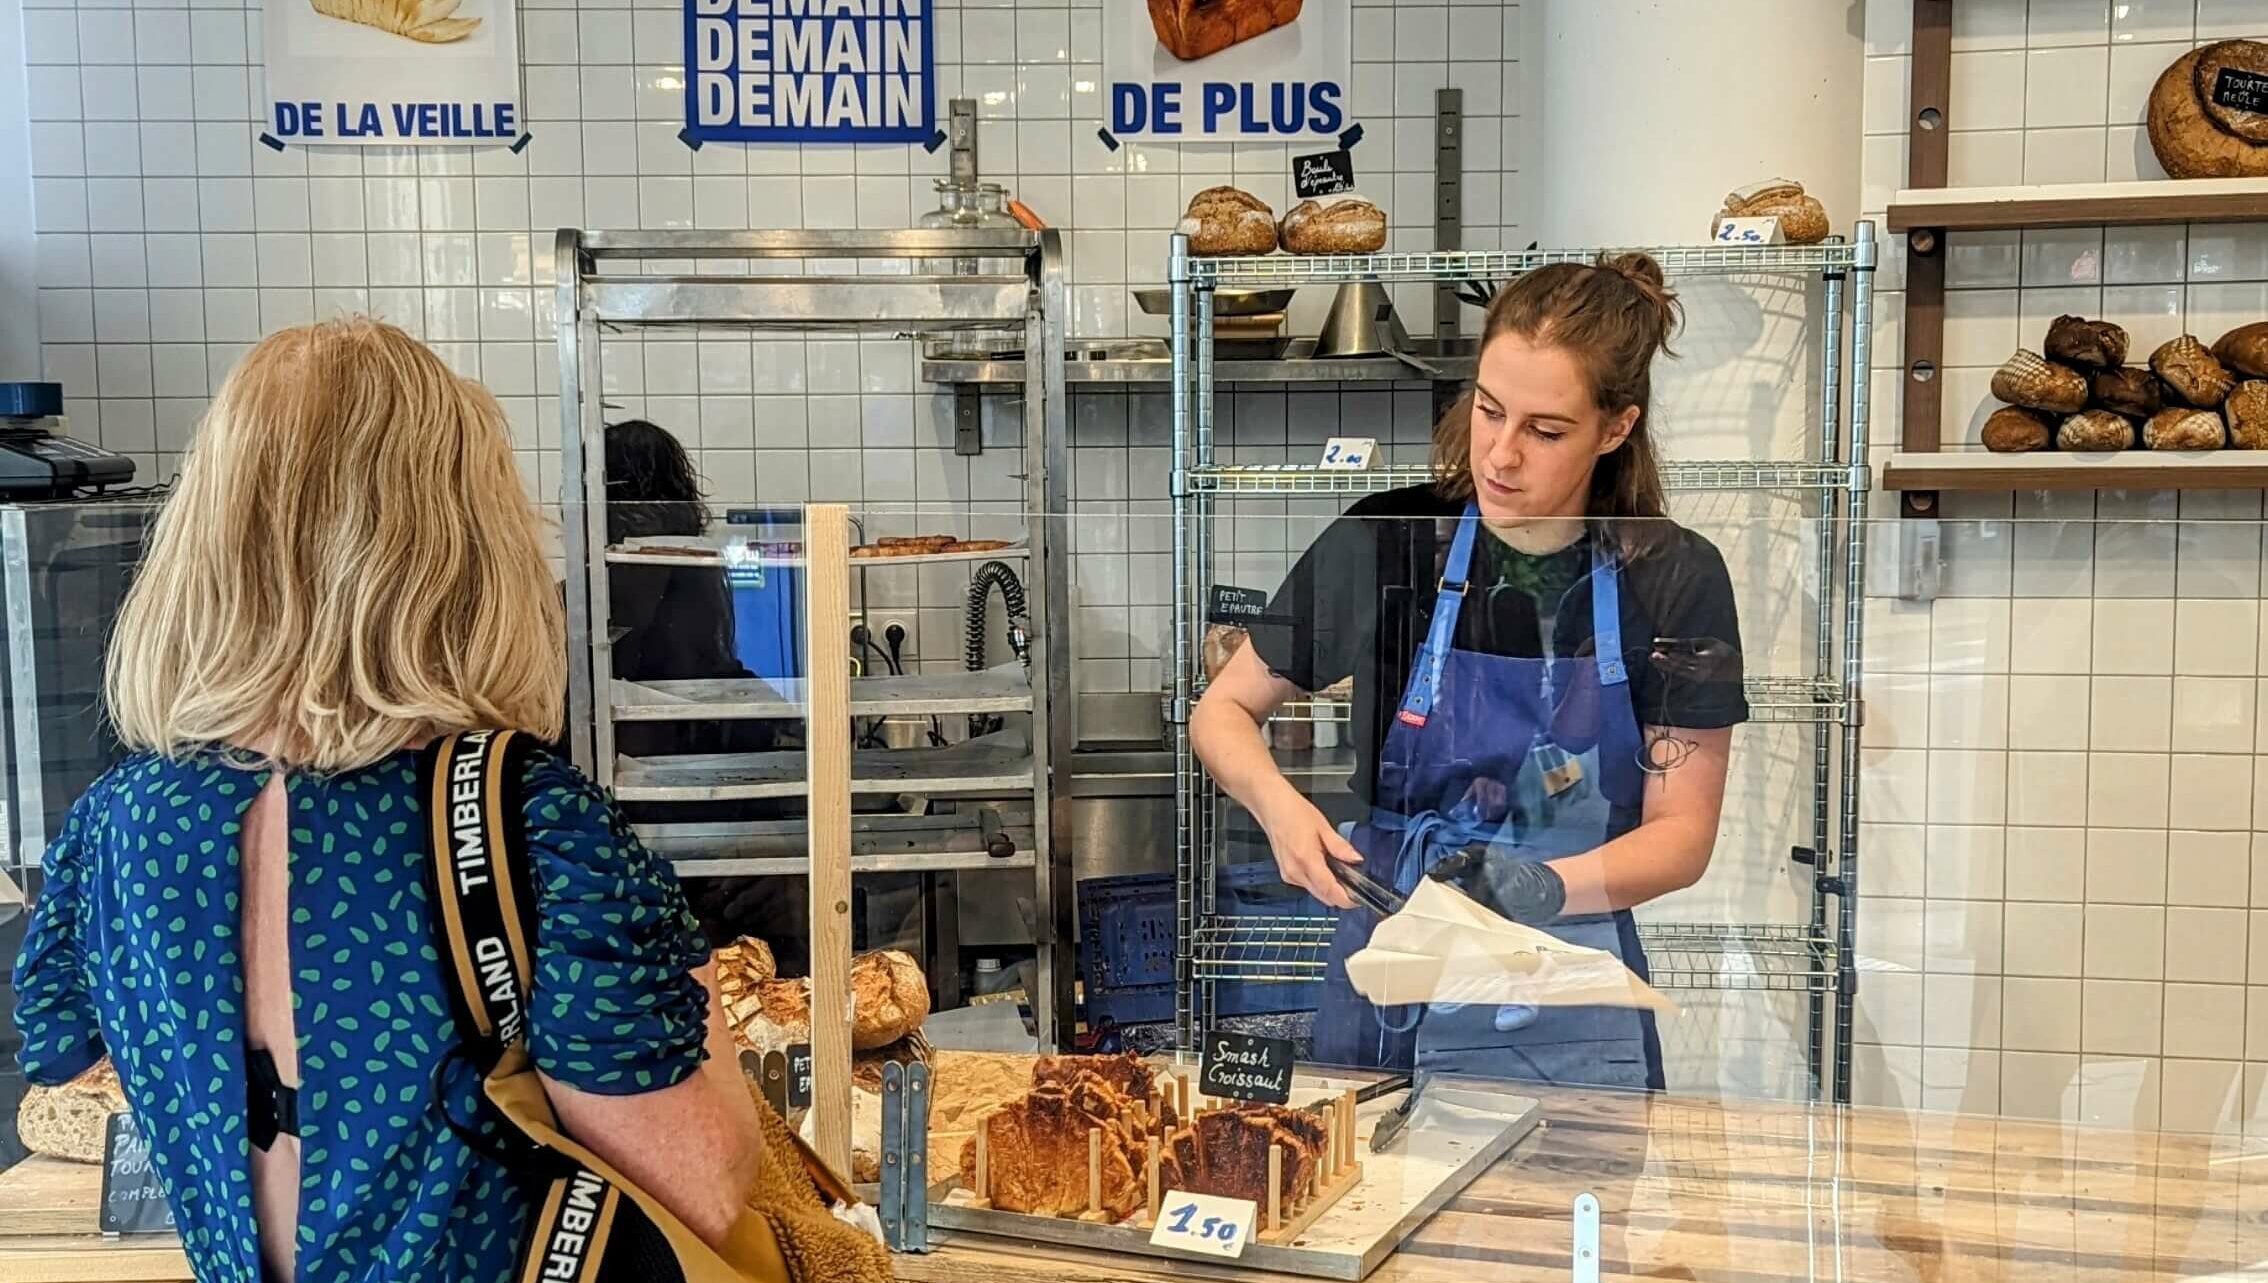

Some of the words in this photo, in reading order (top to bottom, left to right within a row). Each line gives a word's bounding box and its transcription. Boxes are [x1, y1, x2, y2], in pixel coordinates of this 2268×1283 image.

[697, 18, 921, 73] DEMAIN
[275, 102, 324, 137] DE
[336, 102, 384, 137] LA
[392, 103, 516, 138] VEILLE
[698, 73, 922, 127] DEMAIN
[1112, 82, 1183, 134] DE
[1203, 81, 1343, 134] PLUS
[1718, 223, 1761, 241] 2.50
[1219, 590, 1247, 603] PETIT
[475, 936, 521, 1047] RLAND
[1212, 1040, 1271, 1068] Smash
[541, 1170, 604, 1283] IMBER
[1167, 1203, 1238, 1240] 1.50
